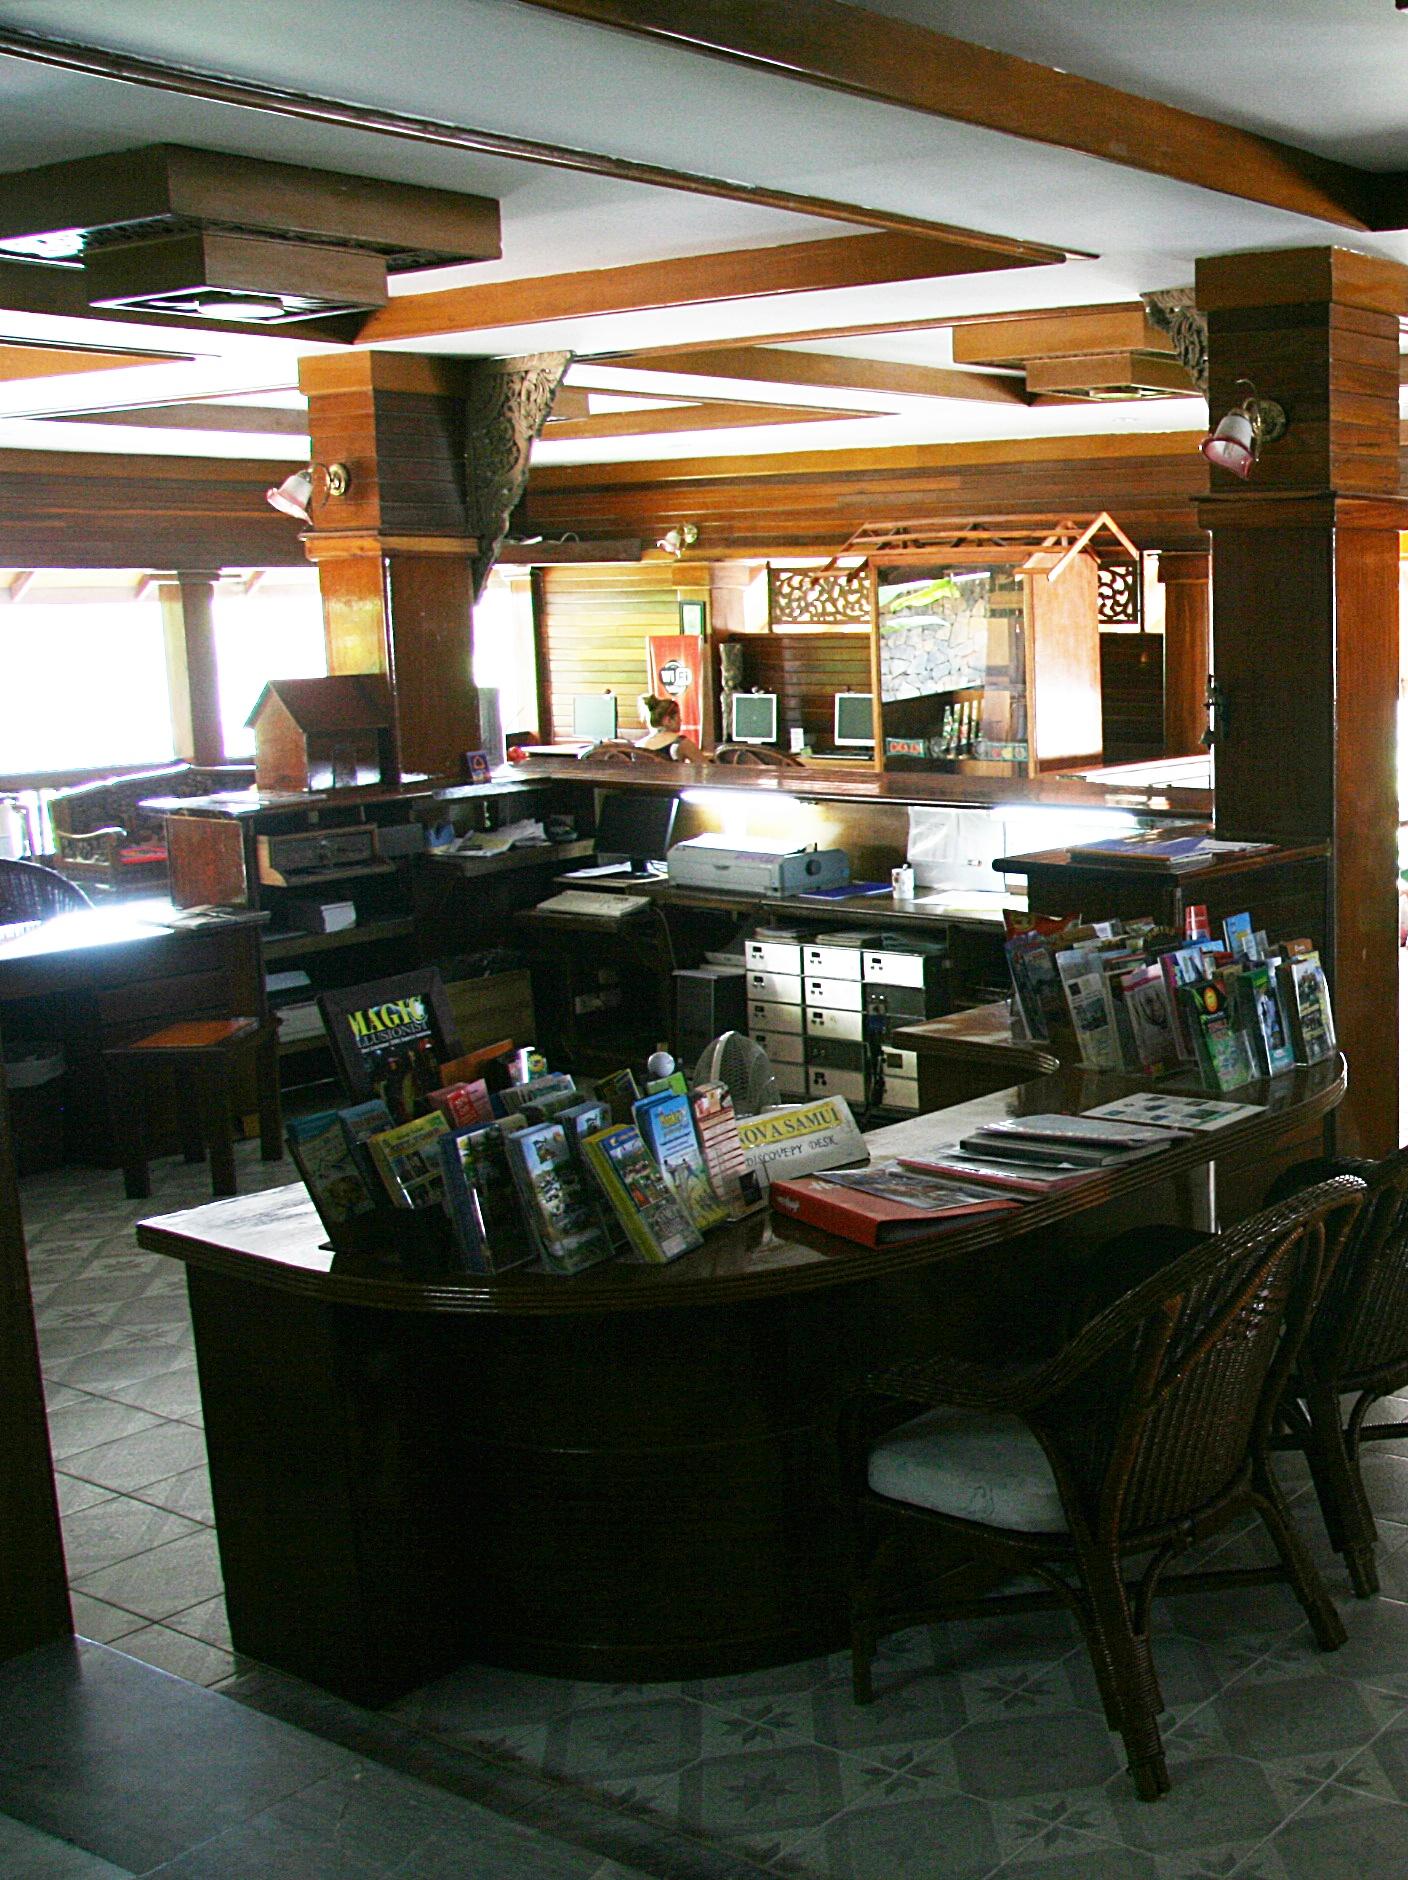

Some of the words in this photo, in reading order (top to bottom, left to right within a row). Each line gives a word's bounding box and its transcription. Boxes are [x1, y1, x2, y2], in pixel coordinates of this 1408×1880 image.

[347, 995, 429, 1037] MAGIC
[783, 1107, 841, 1134] SAMUI
[808, 1134, 839, 1150] DESK
